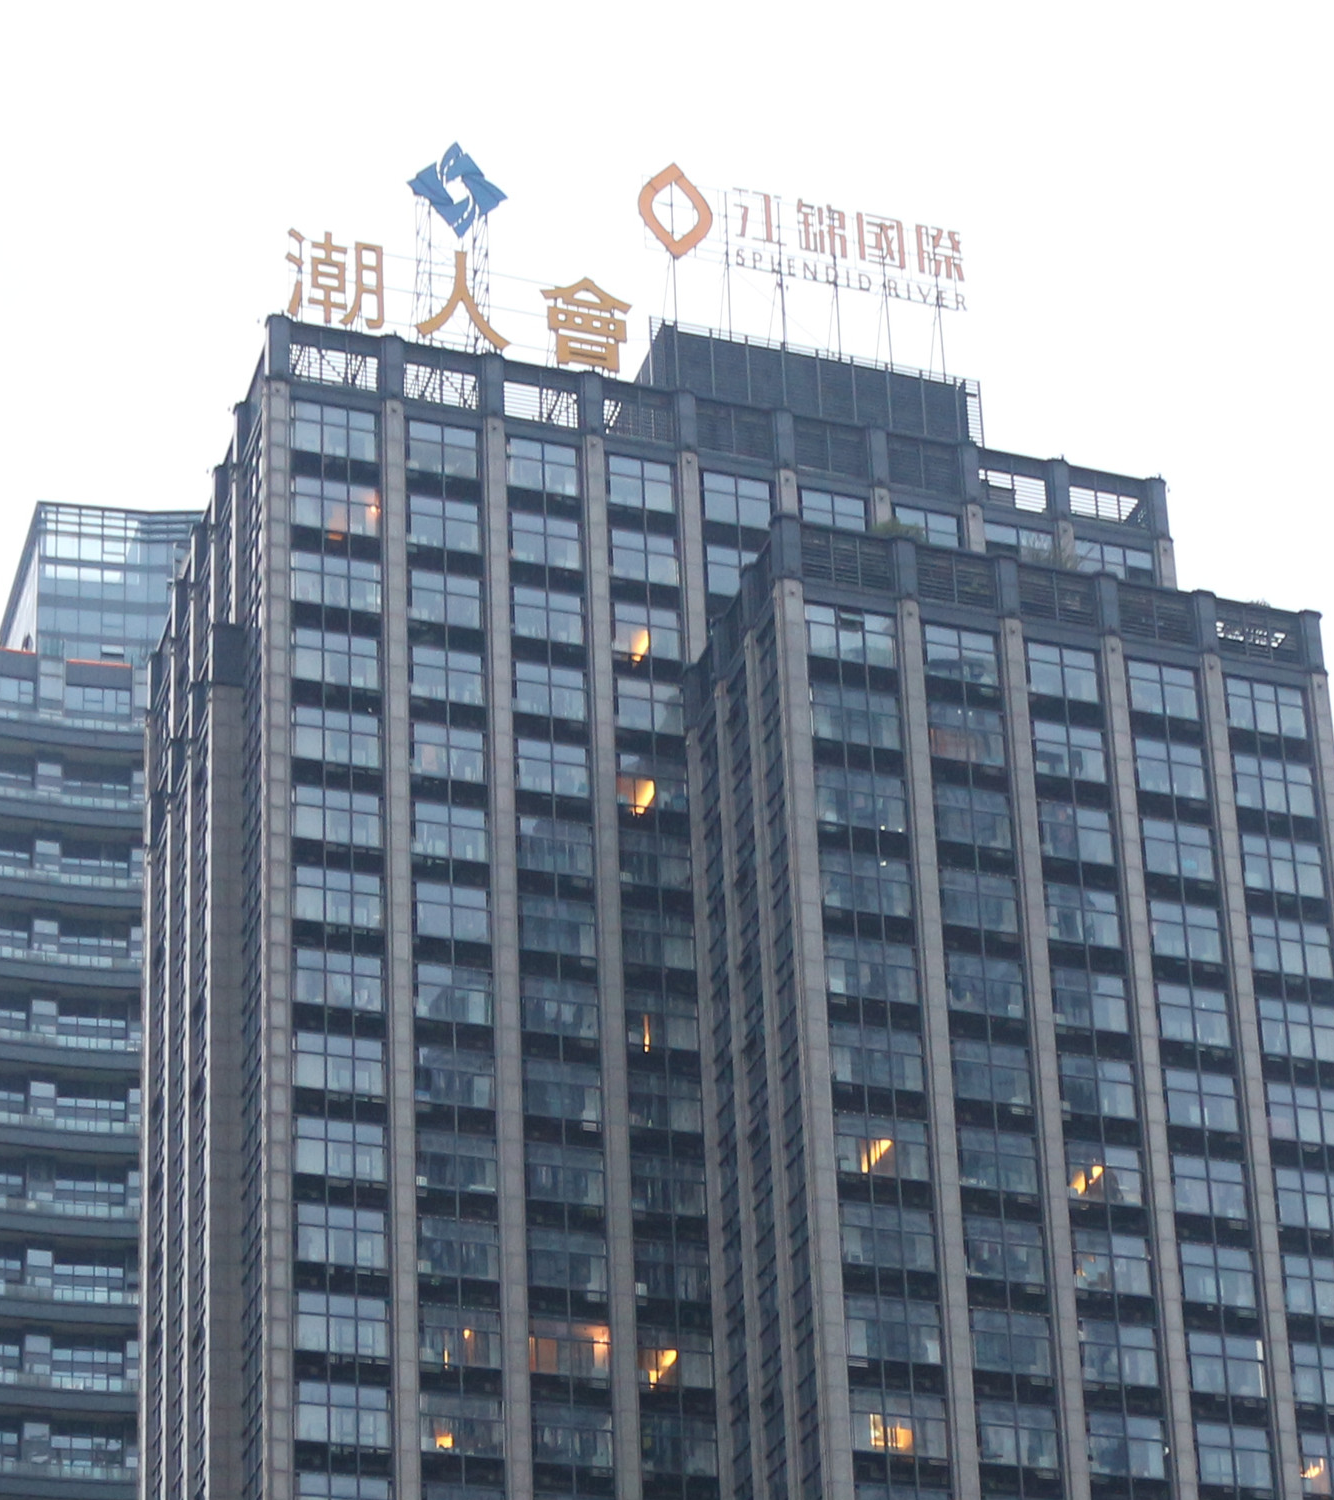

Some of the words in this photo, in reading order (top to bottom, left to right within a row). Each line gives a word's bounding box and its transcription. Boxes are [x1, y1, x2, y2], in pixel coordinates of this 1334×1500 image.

[732, 187, 965, 282] 江錦國際
[736, 248, 872, 292] SPLENDID
[886, 278, 967, 311] RIVER
[287, 227, 632, 373] 潮人會
